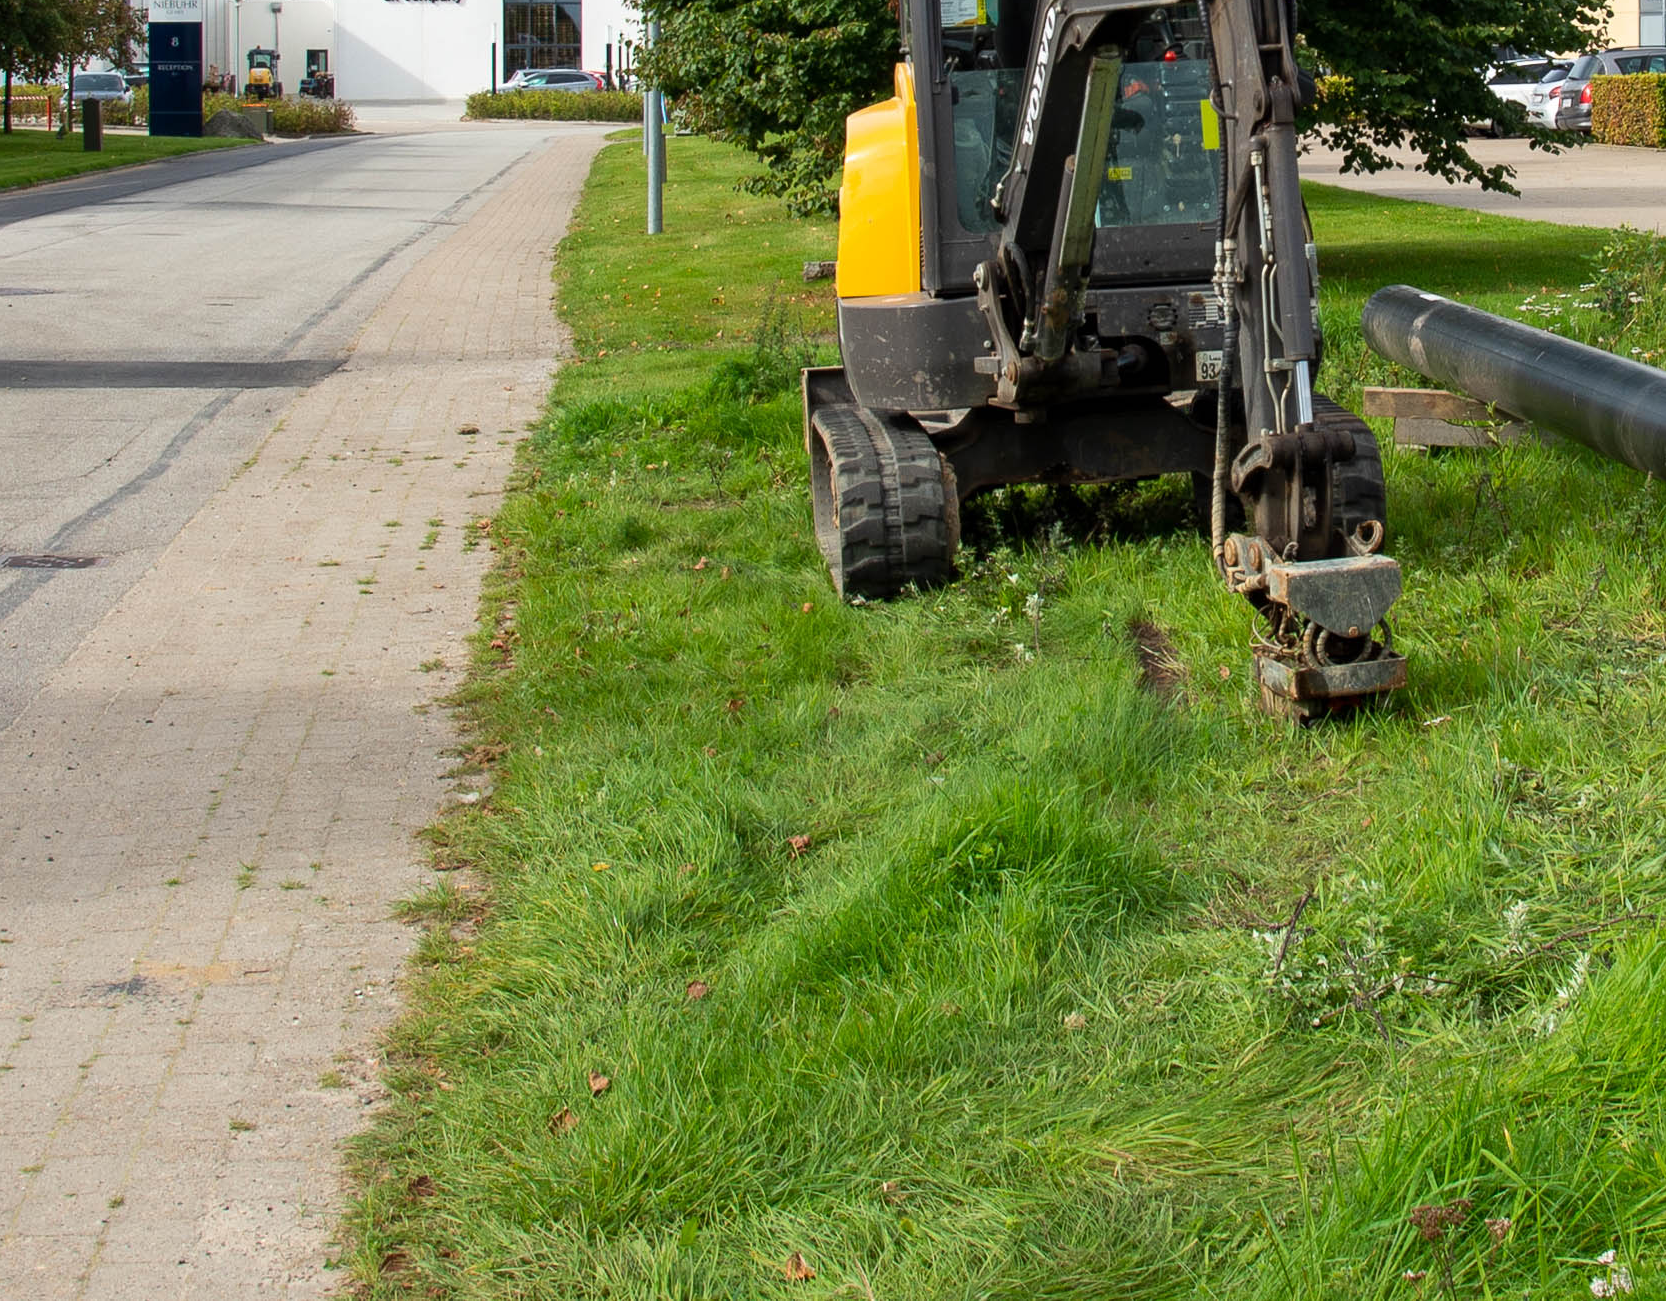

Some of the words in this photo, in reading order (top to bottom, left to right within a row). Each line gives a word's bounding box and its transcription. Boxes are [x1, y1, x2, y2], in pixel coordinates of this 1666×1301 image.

[154, 0, 198, 9] NIEBUHR
[171, 36, 179, 47] 8
[1022, 7, 1056, 145] VOLVO
[1201, 363, 1217, 380] 93
